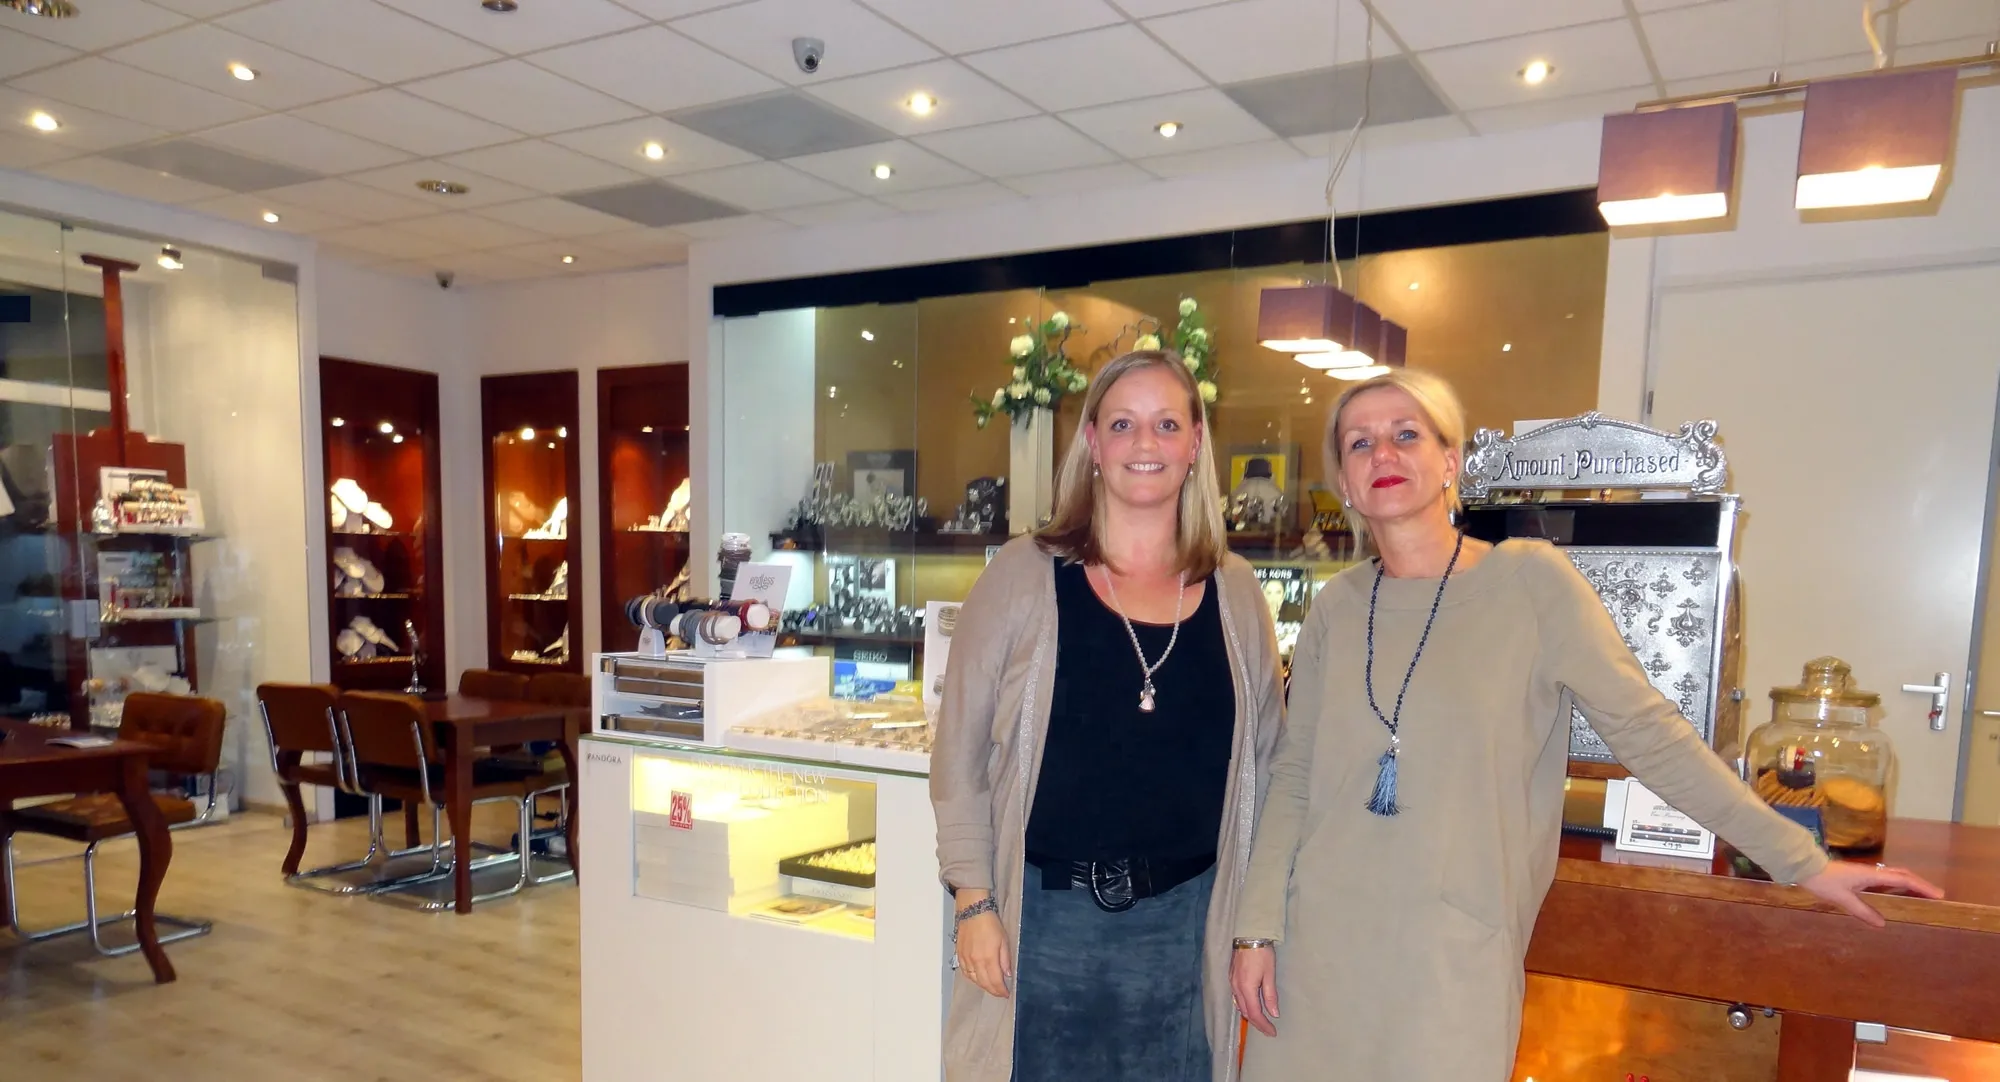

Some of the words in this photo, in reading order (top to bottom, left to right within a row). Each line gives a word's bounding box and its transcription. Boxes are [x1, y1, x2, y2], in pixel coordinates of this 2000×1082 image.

[1492, 450, 1566, 481] Amount
[1567, 450, 1679, 480] Purchased
[853, 649, 888, 662] SEIKO
[587, 752, 622, 764] PANDORA
[792, 767, 828, 785] NEW
[671, 794, 691, 824] 25%
